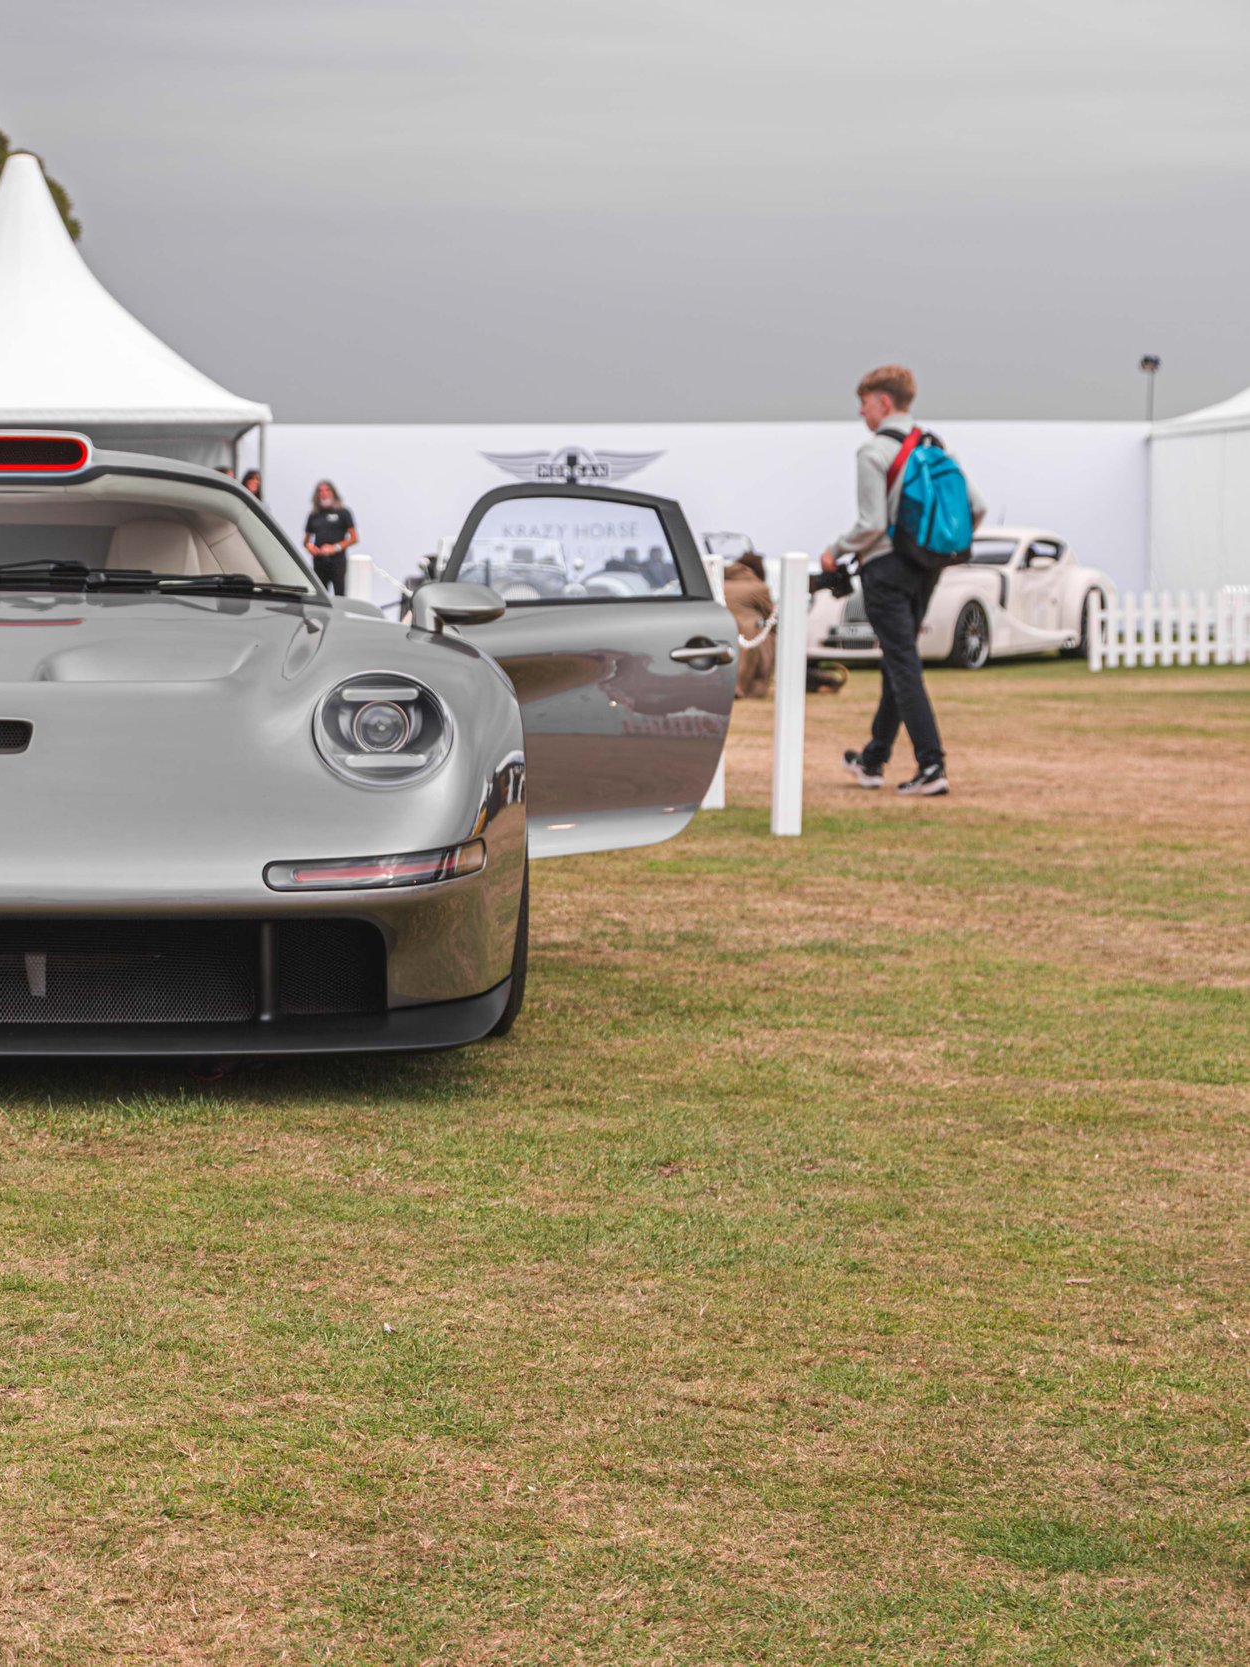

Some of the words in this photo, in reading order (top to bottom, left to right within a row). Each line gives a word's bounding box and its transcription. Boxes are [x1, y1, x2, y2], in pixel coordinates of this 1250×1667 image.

[537, 463, 607, 477] MORGAN
[502, 522, 566, 539] KRAZY
[573, 520, 639, 538] HORSE
